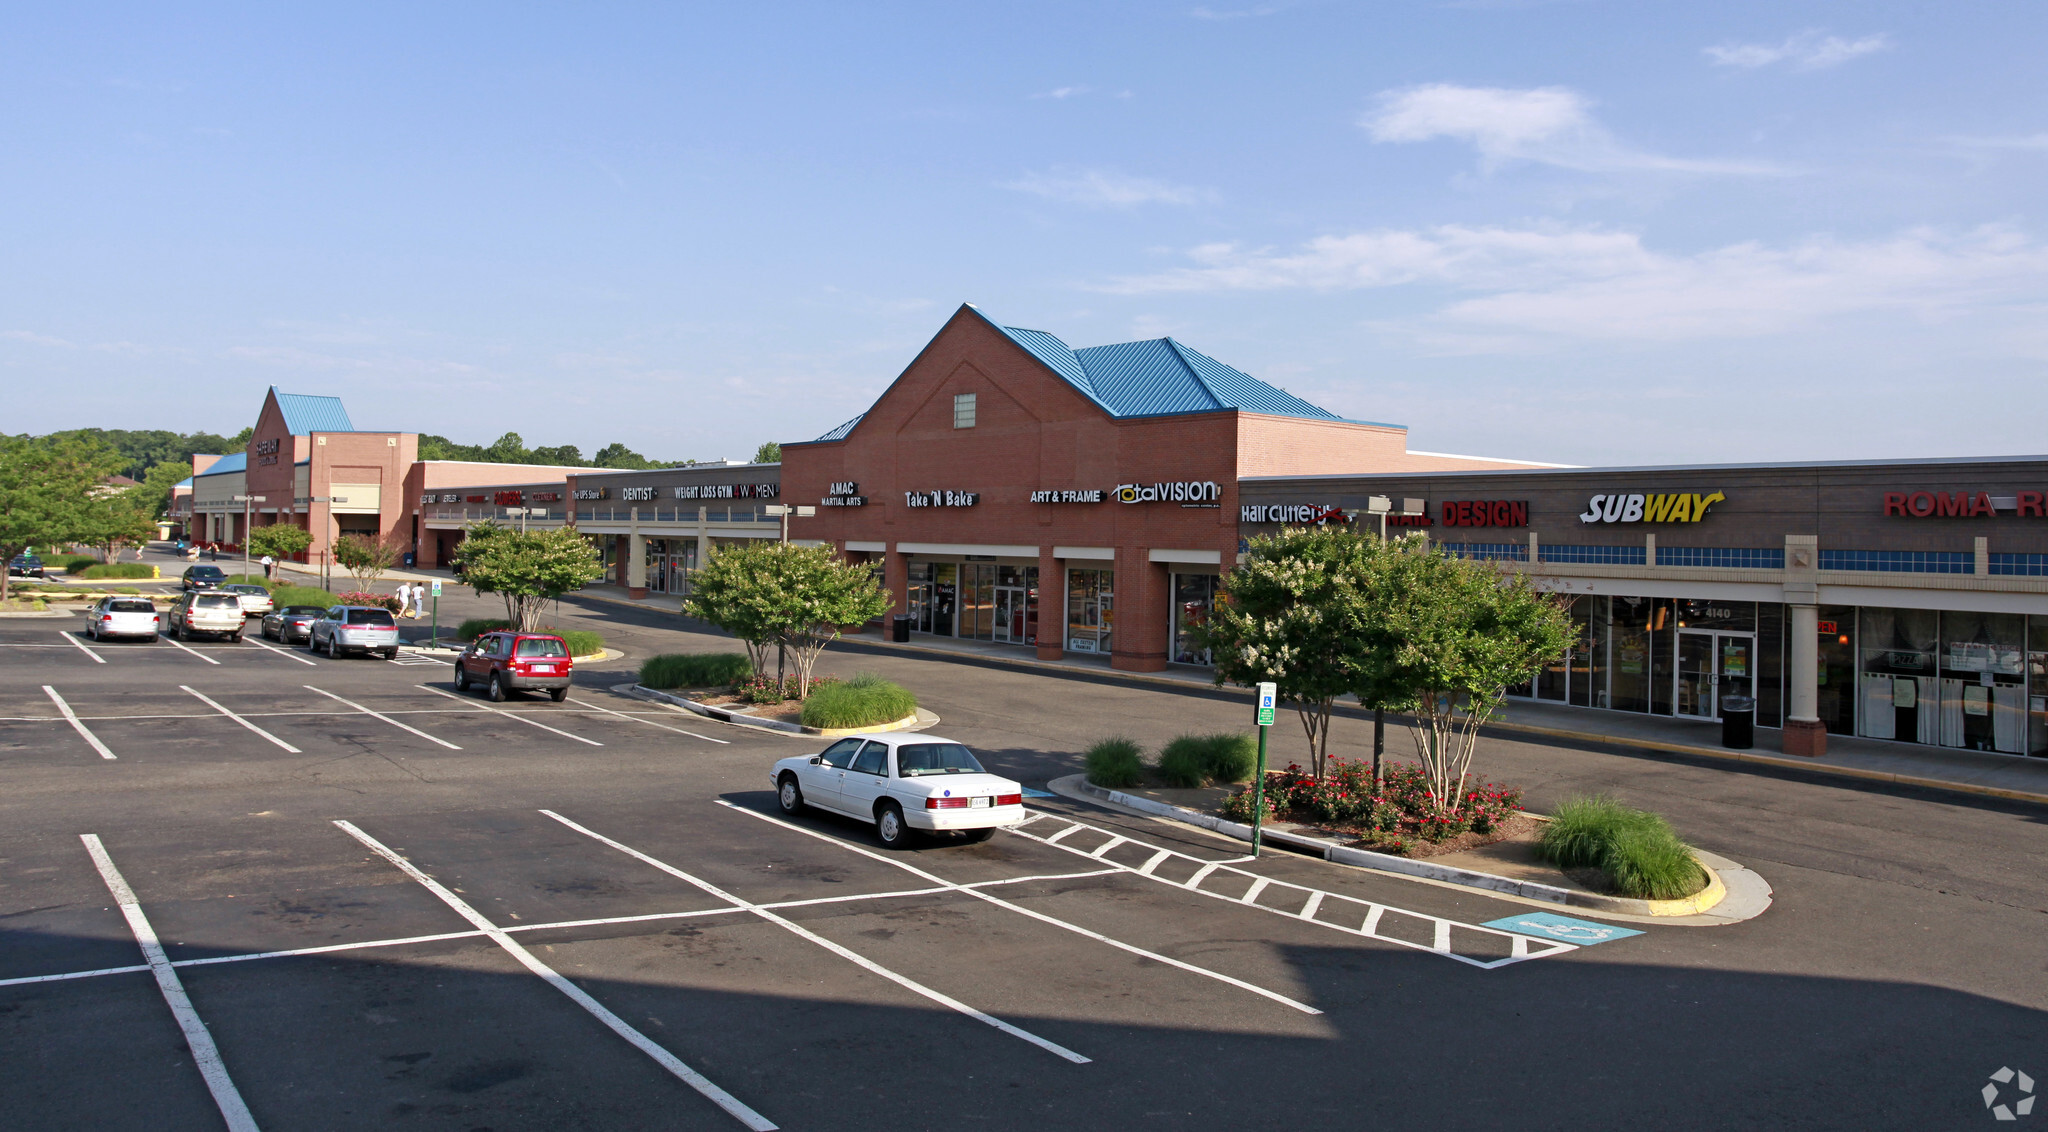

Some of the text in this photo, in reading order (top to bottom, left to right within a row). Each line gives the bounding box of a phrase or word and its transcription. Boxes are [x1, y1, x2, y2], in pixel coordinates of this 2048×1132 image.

[579, 490, 588, 499] UPS
[588, 490, 599, 499] Store
[623, 487, 652, 500] DENTIST
[675, 486, 699, 499] WEIGHT
[700, 485, 716, 498] LOSS
[717, 485, 733, 498] GYM
[830, 481, 854, 495] AMAC
[821, 497, 862, 506] MARTIAL ARTS
[905, 491, 928, 507] Take
[946, 490, 972, 507] Bake
[1030, 490, 1100, 502] ART & FRAME
[1580, 490, 1726, 523] SUBWAY
[1883, 490, 2048, 517] ROMA R
[1441, 501, 1527, 527] DESIGN
[1706, 608, 1731, 619] 4140
[1817, 621, 1837, 633] PEN
[1893, 655, 1921, 667] PIZZA
